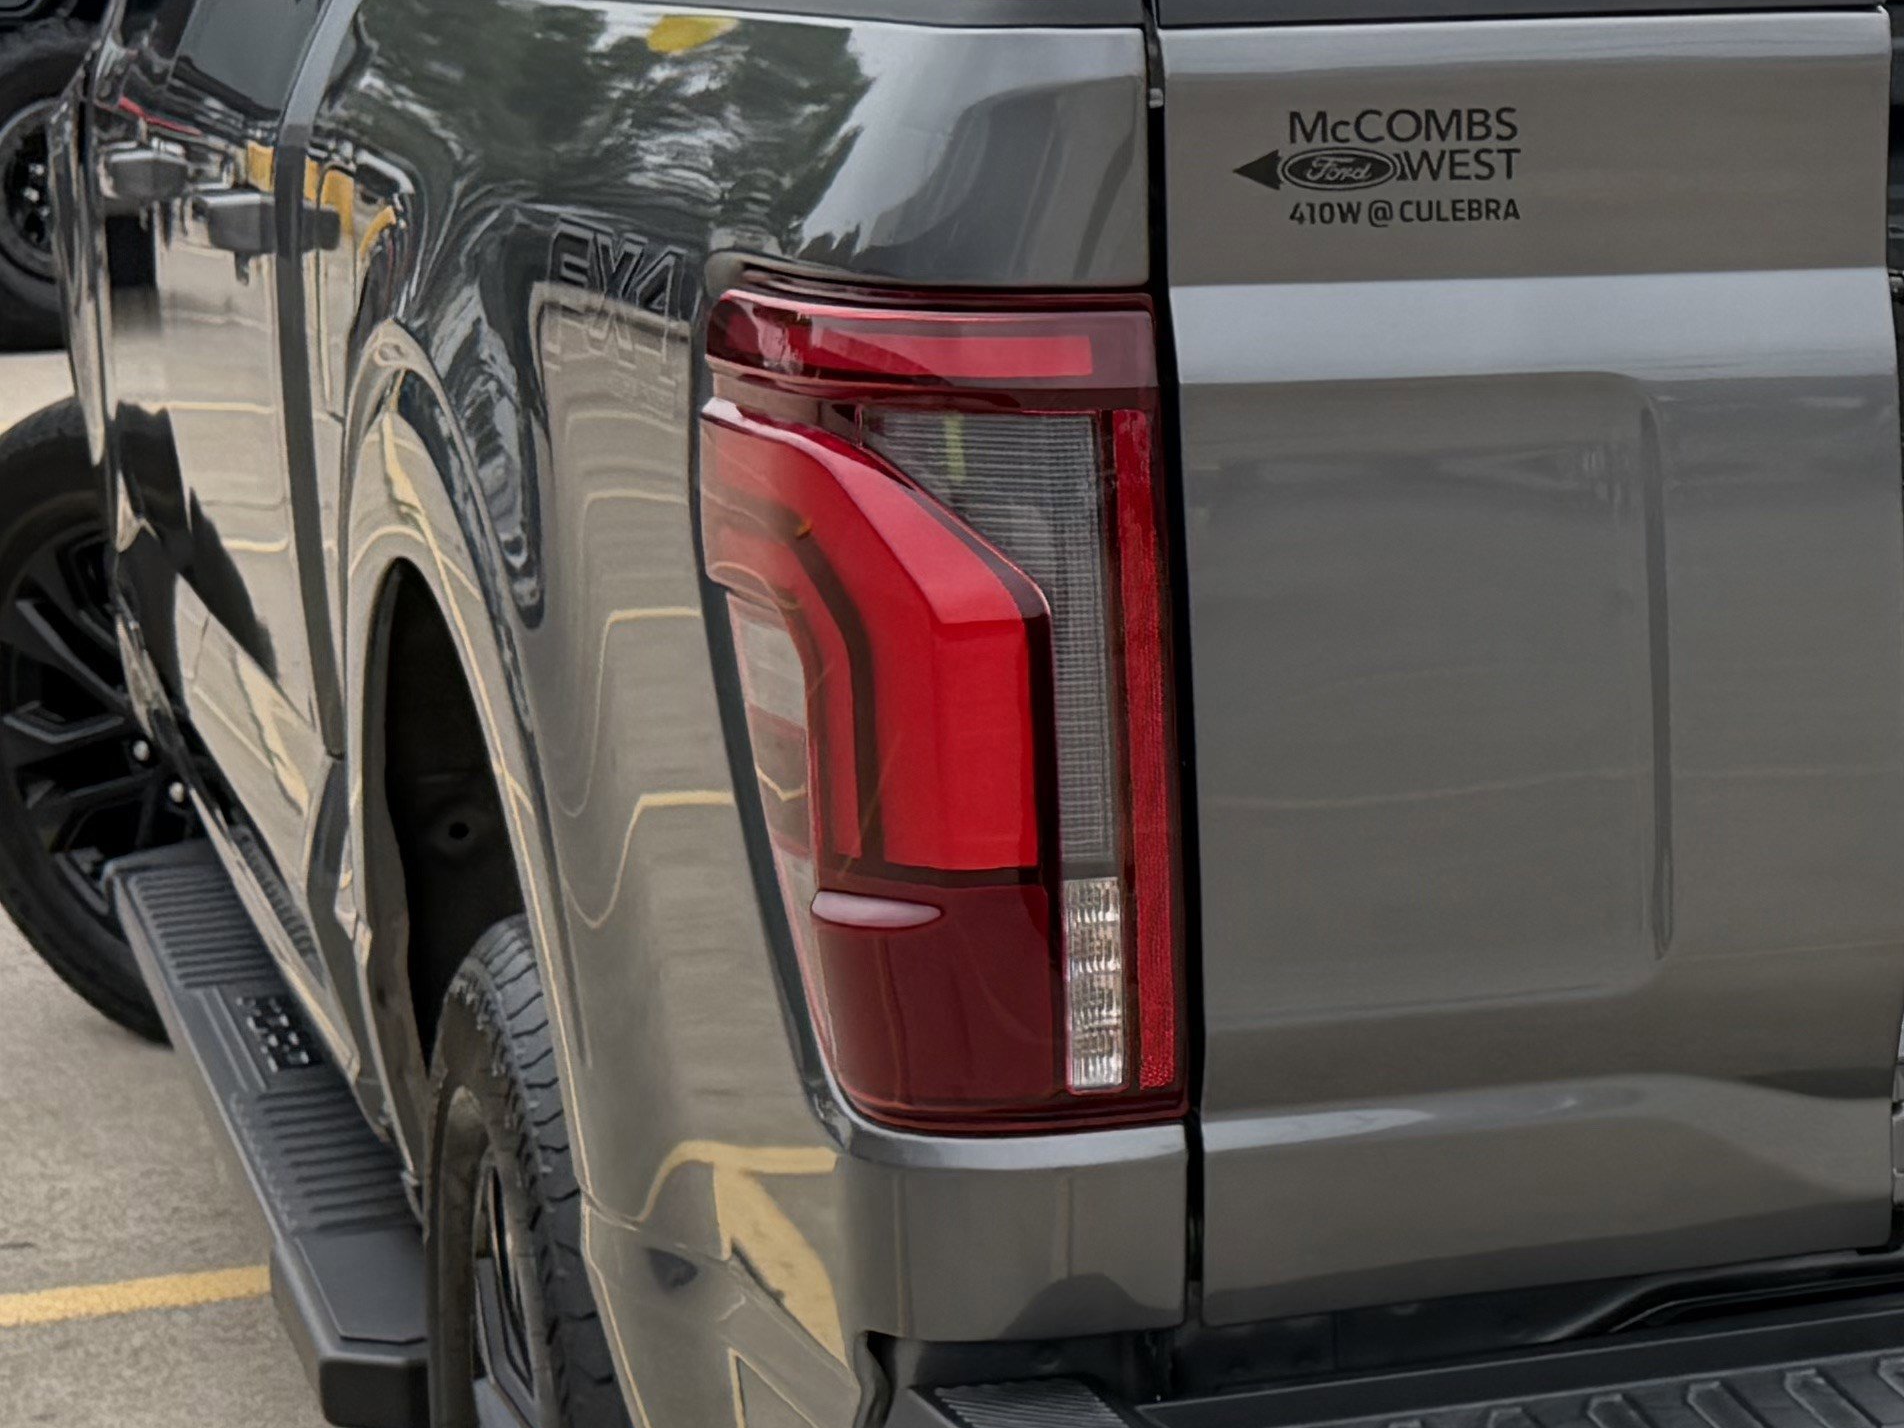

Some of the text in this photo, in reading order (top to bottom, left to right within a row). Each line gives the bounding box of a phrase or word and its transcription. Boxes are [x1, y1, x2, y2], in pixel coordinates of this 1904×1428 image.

[1289, 107, 1519, 145] McCOMBS
[1306, 154, 1373, 182] Ford
[1402, 147, 1521, 182] WEST
[1289, 198, 1521, 228] 410W @ CULEBRA
